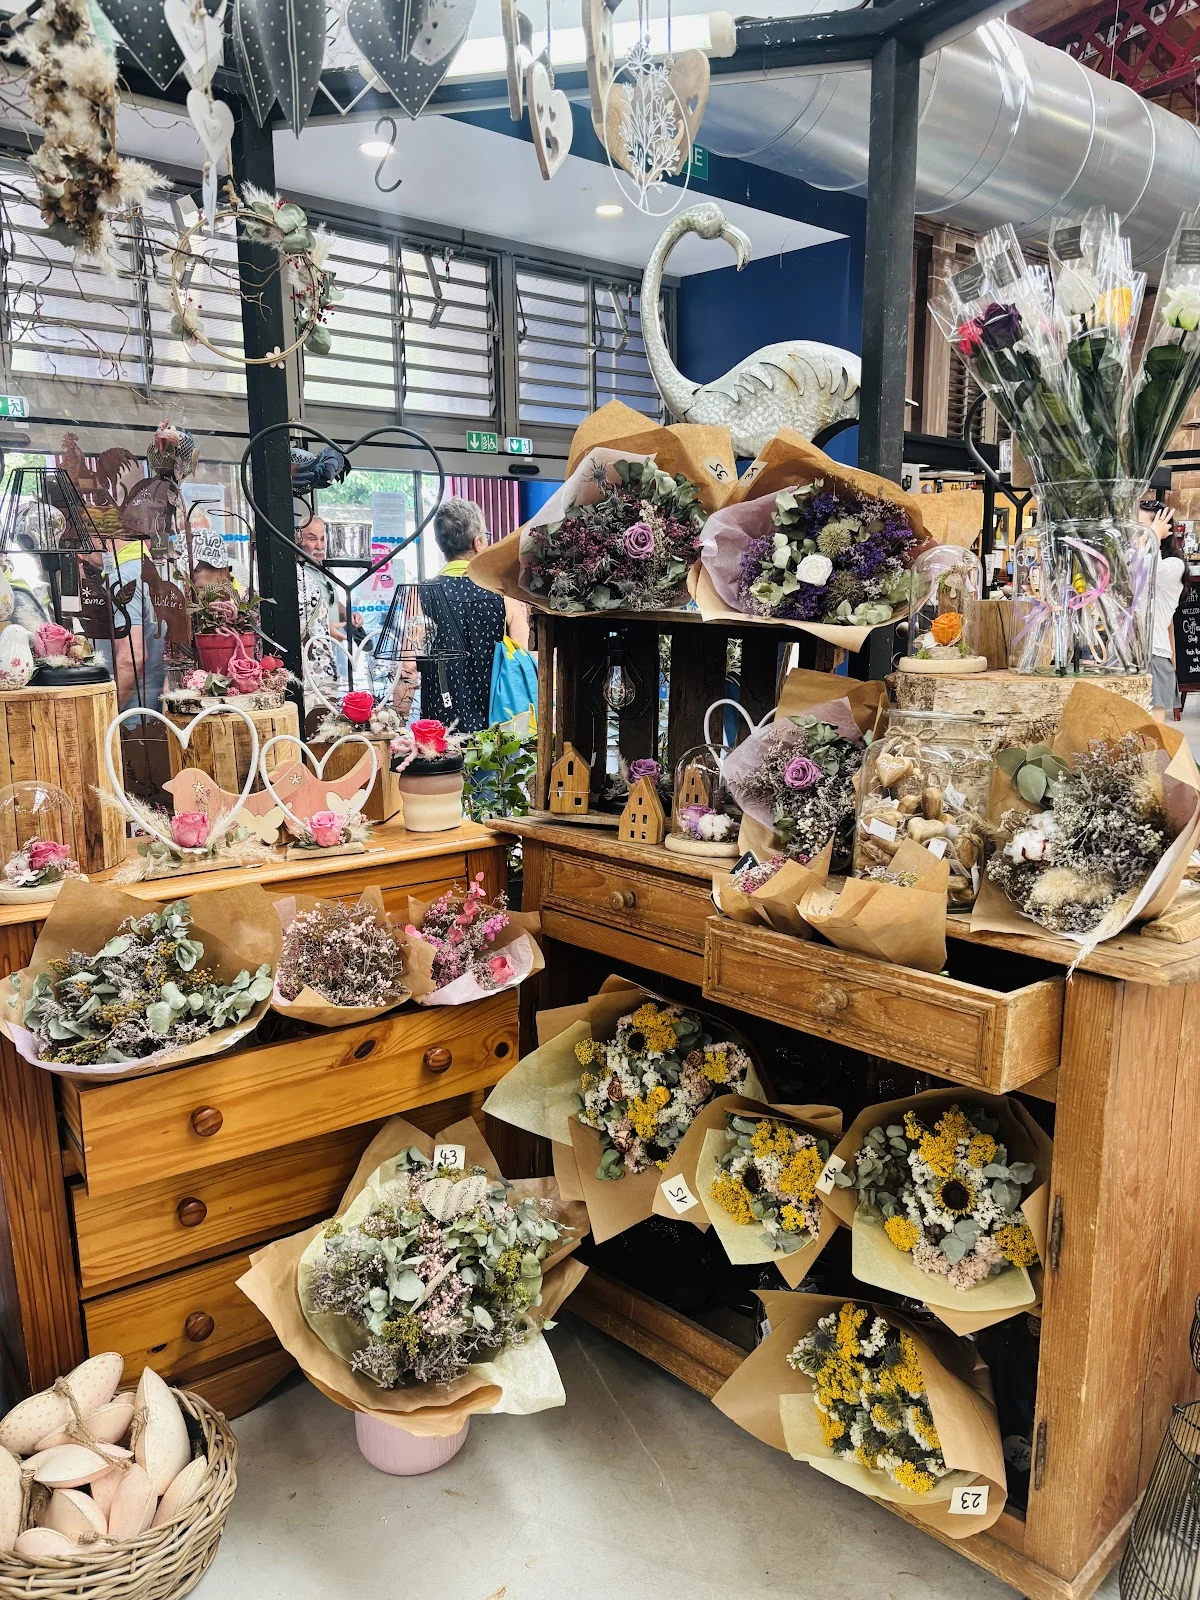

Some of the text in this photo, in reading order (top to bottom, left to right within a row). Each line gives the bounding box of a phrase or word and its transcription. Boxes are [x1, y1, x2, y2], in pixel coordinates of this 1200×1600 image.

[709, 463, 729, 481] 35
[440, 1149, 458, 1165] 43
[823, 1166, 837, 1184] 16
[668, 1187, 688, 1204] 15
[960, 1491, 982, 1510] 23
